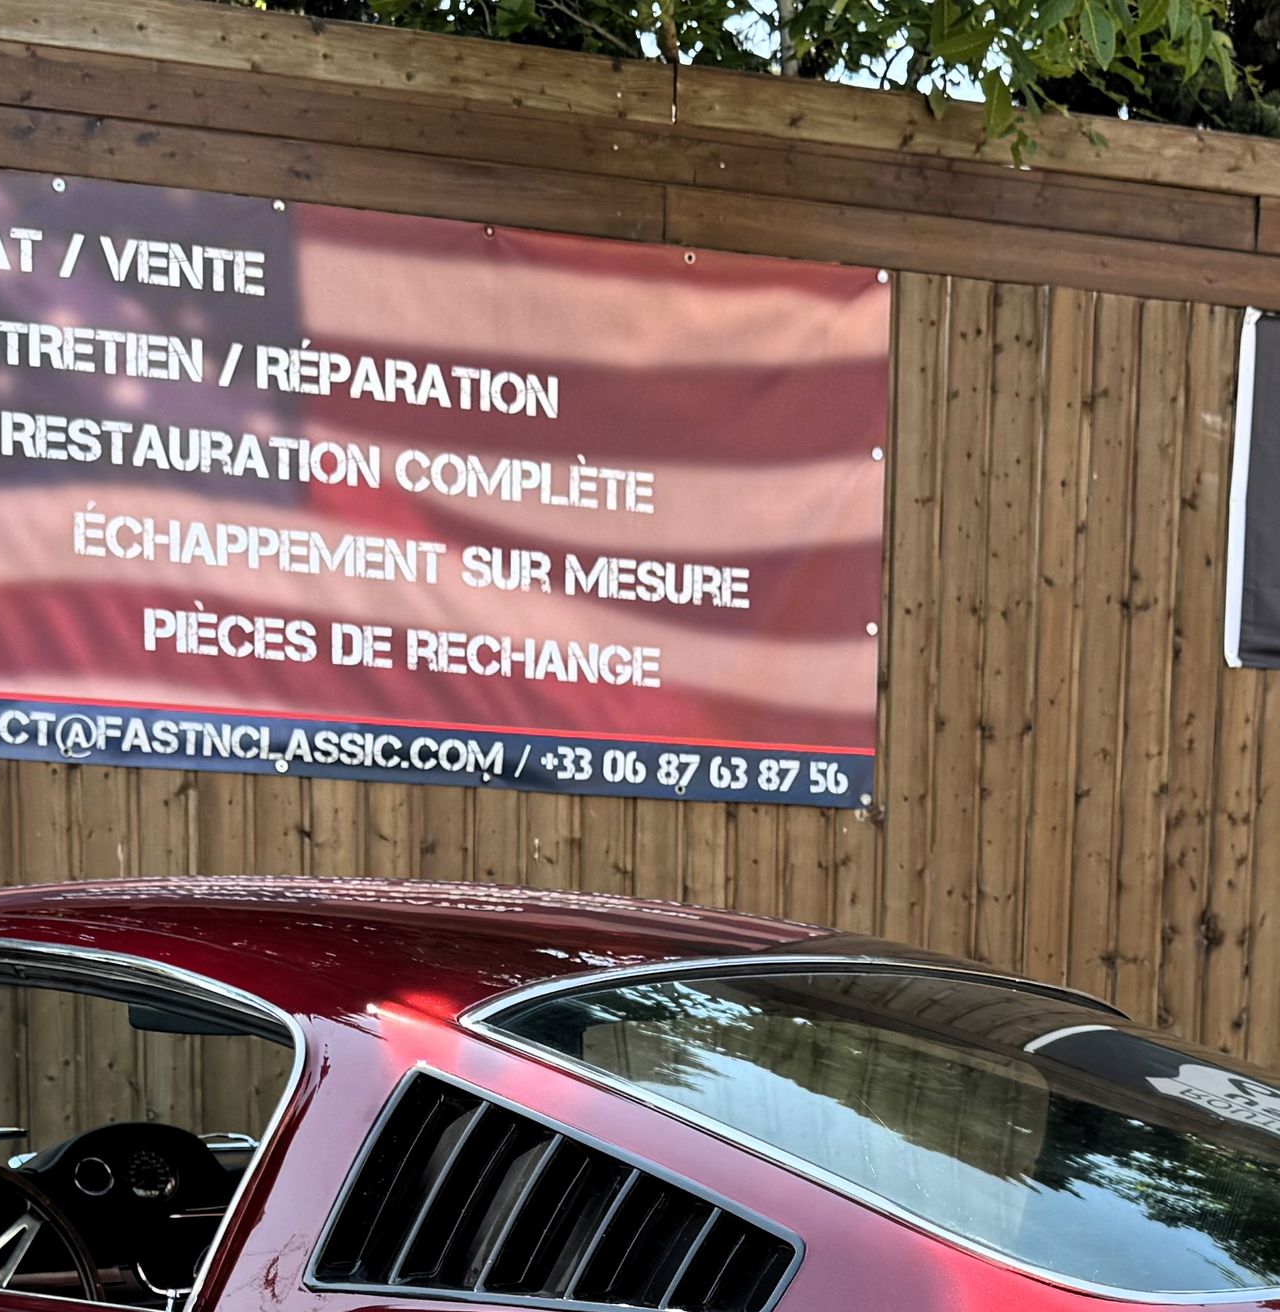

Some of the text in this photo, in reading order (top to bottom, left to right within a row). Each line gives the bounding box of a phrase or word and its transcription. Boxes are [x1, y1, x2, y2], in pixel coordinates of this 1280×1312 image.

[59, 233, 85, 279] /
[100, 236, 266, 297] VENTE
[218, 343, 243, 388] /
[256, 339, 559, 419] RÉPARATION
[1, 411, 655, 515] RESTAURATION COMPLÈTE
[73, 500, 750, 609] ÉCHAPPEMENT SUR MESURE
[143, 600, 661, 689] PIÈCES DE RECHANGE
[514, 744, 532, 779] /
[540, 746, 593, 782] +33
[603, 749, 647, 785] 06
[656, 753, 700, 789] 87
[709, 756, 748, 790] 63
[757, 759, 800, 793] 87
[809, 761, 849, 796] 56
